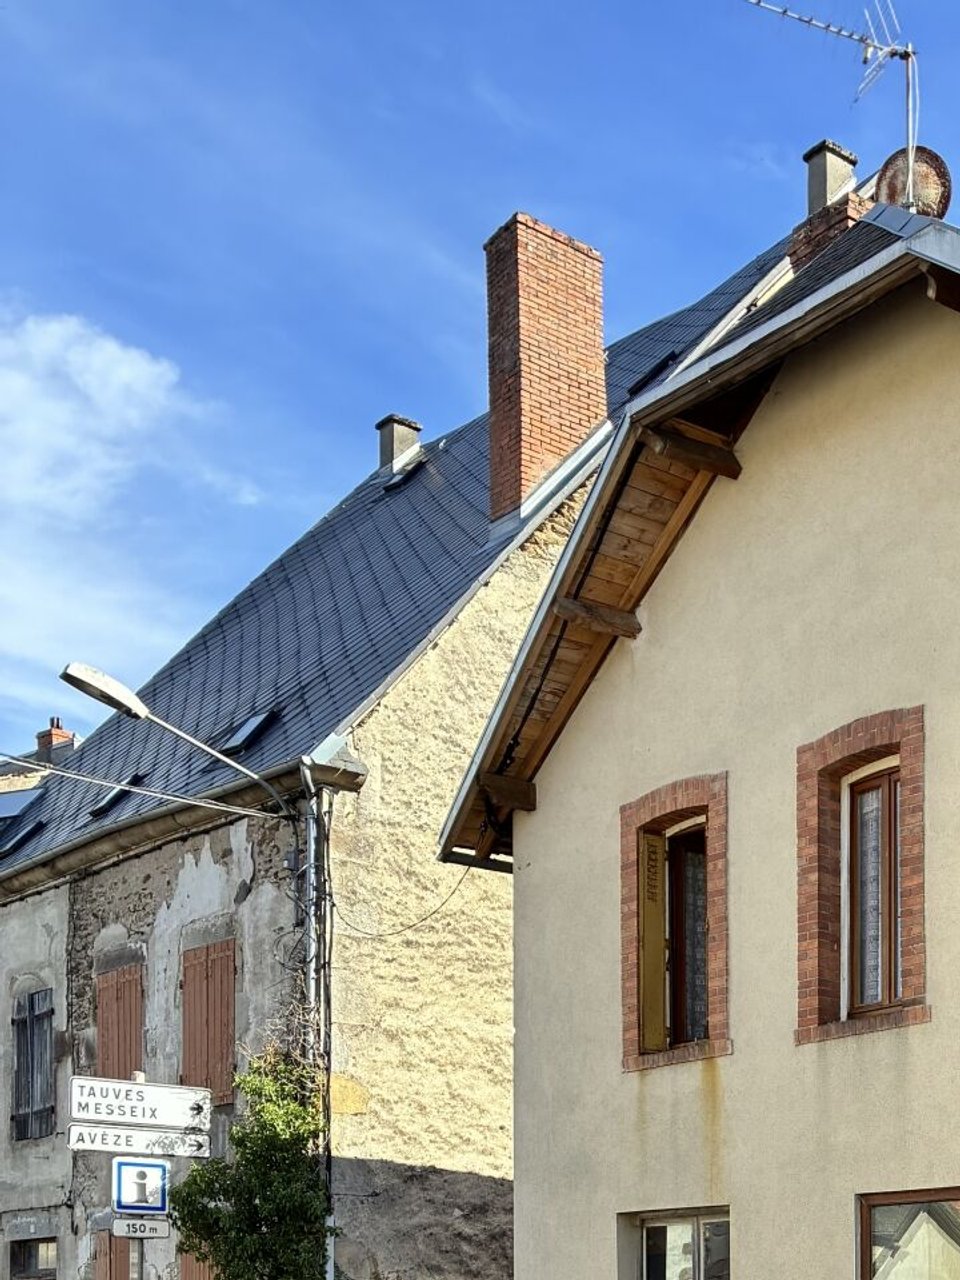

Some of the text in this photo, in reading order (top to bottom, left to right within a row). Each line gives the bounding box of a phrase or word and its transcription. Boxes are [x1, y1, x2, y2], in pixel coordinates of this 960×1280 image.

[78, 1085, 145, 1101] TAUVES
[77, 1102, 158, 1119] MESSEIX
[126, 1223, 147, 1234] 150
